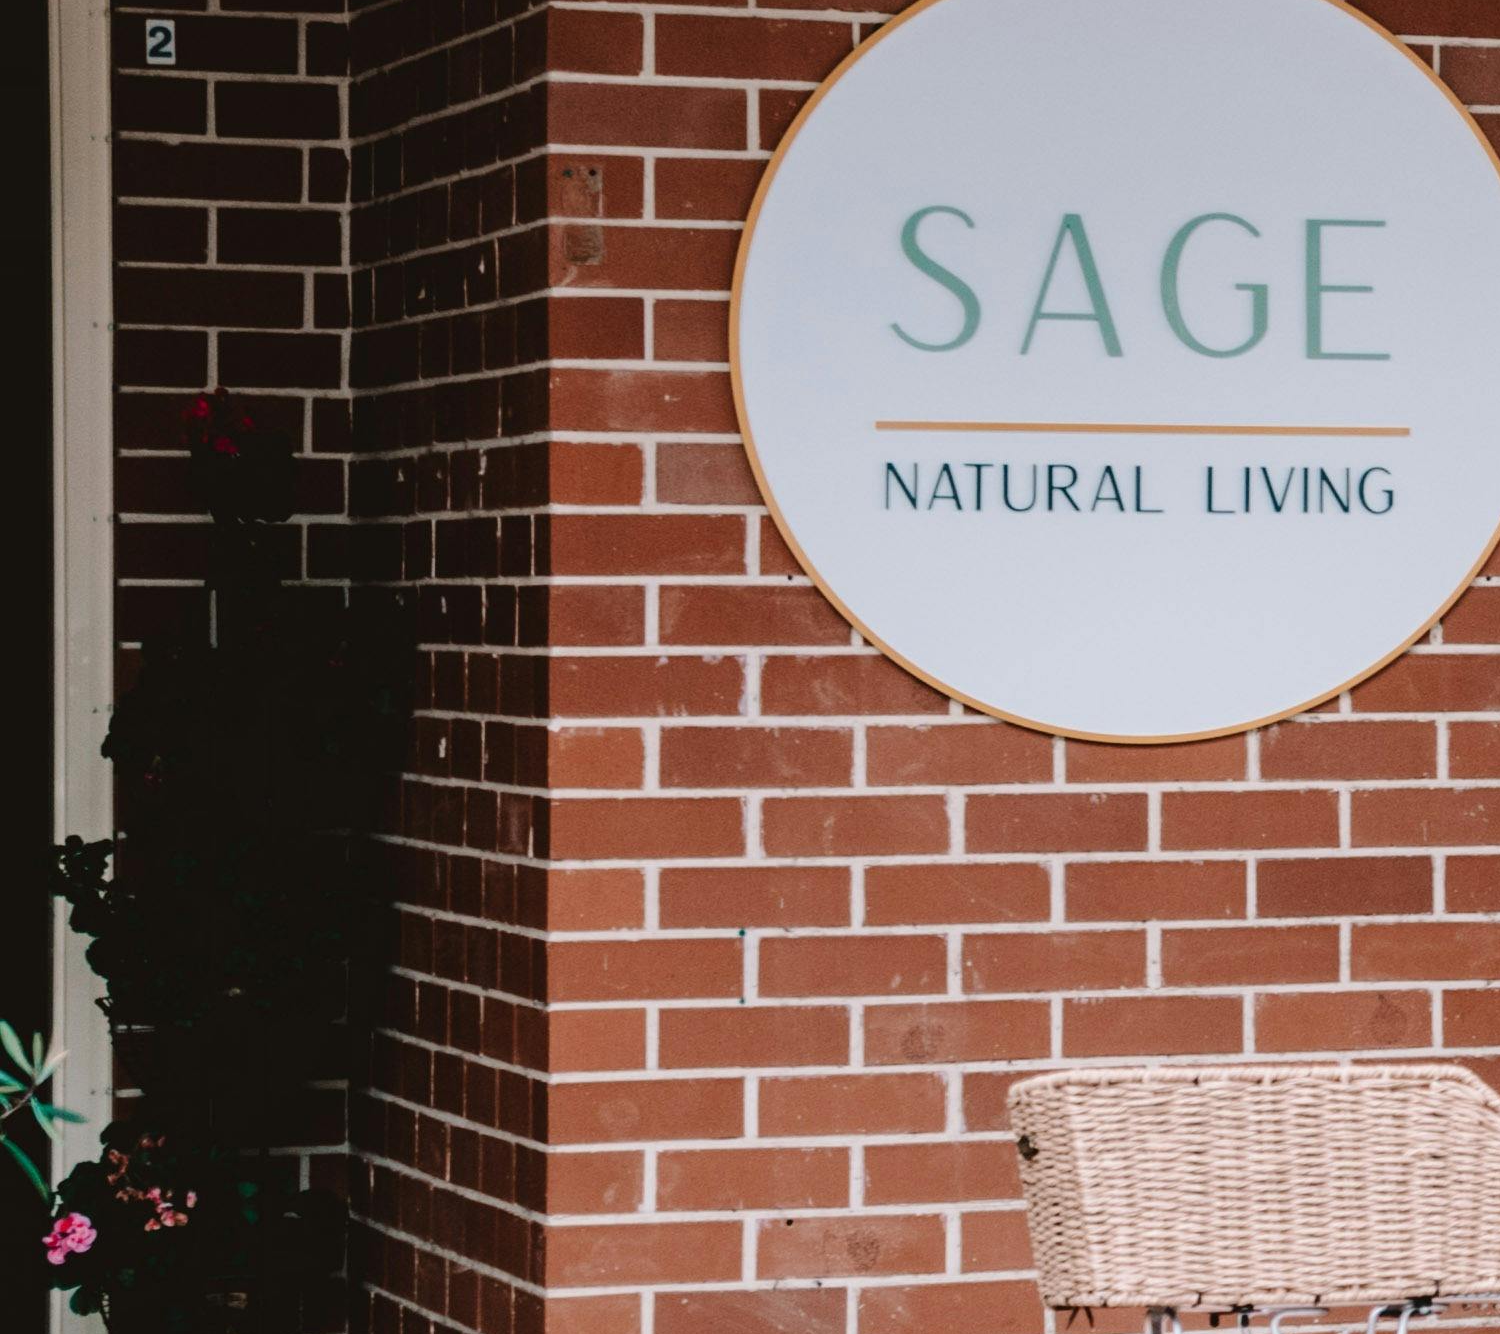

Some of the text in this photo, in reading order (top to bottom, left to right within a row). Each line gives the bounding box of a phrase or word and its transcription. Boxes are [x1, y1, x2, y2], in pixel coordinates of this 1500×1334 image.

[148, 26, 173, 58] 2
[889, 204, 1391, 360] SAGE
[884, 461, 1395, 515] NATURAL LIVING
